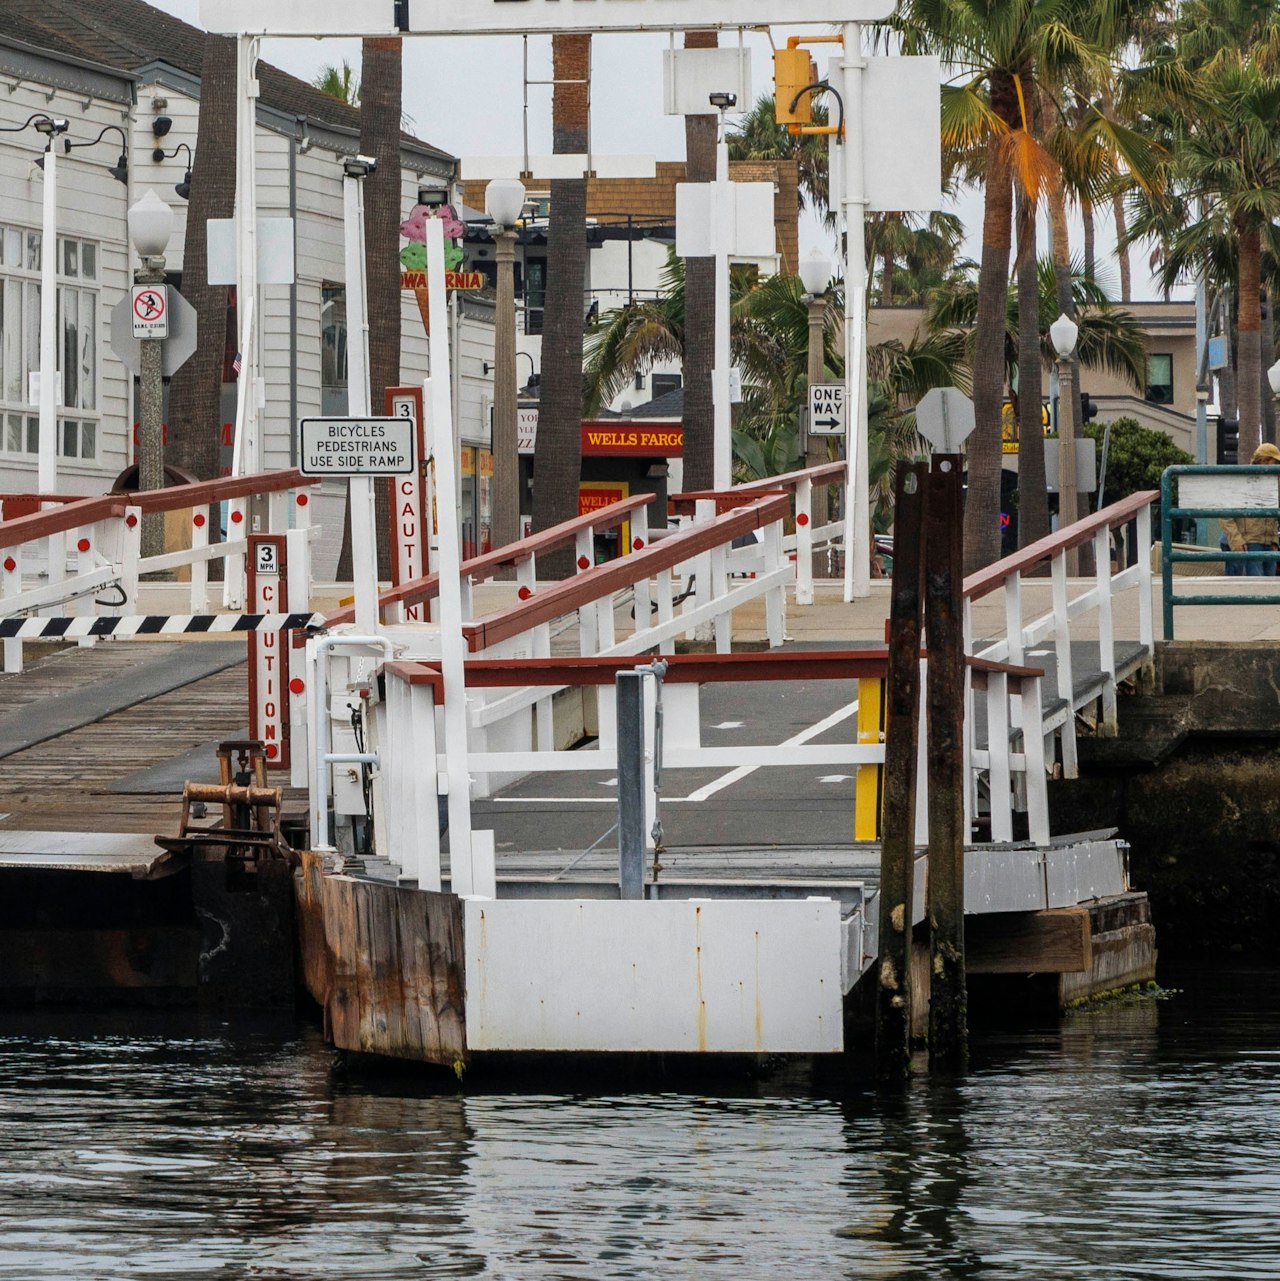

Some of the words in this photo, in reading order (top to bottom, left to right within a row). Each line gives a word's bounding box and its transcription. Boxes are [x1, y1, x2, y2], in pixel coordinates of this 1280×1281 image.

[814, 389, 842, 401] ONE
[400, 404, 410, 418] 3
[813, 403, 842, 414] WAY
[328, 426, 385, 438] BICYCLES
[588, 432, 637, 446] WELLS
[317, 441, 397, 452] PEDESTRIANS
[310, 456, 333, 467] USE
[338, 456, 364, 467] SIDE
[369, 456, 405, 467] RAMP
[261, 546, 273, 562] 3
[401, 481, 418, 621] CAUTIN
[260, 562, 274, 570] MPH
[262, 585, 276, 740] CUTION
